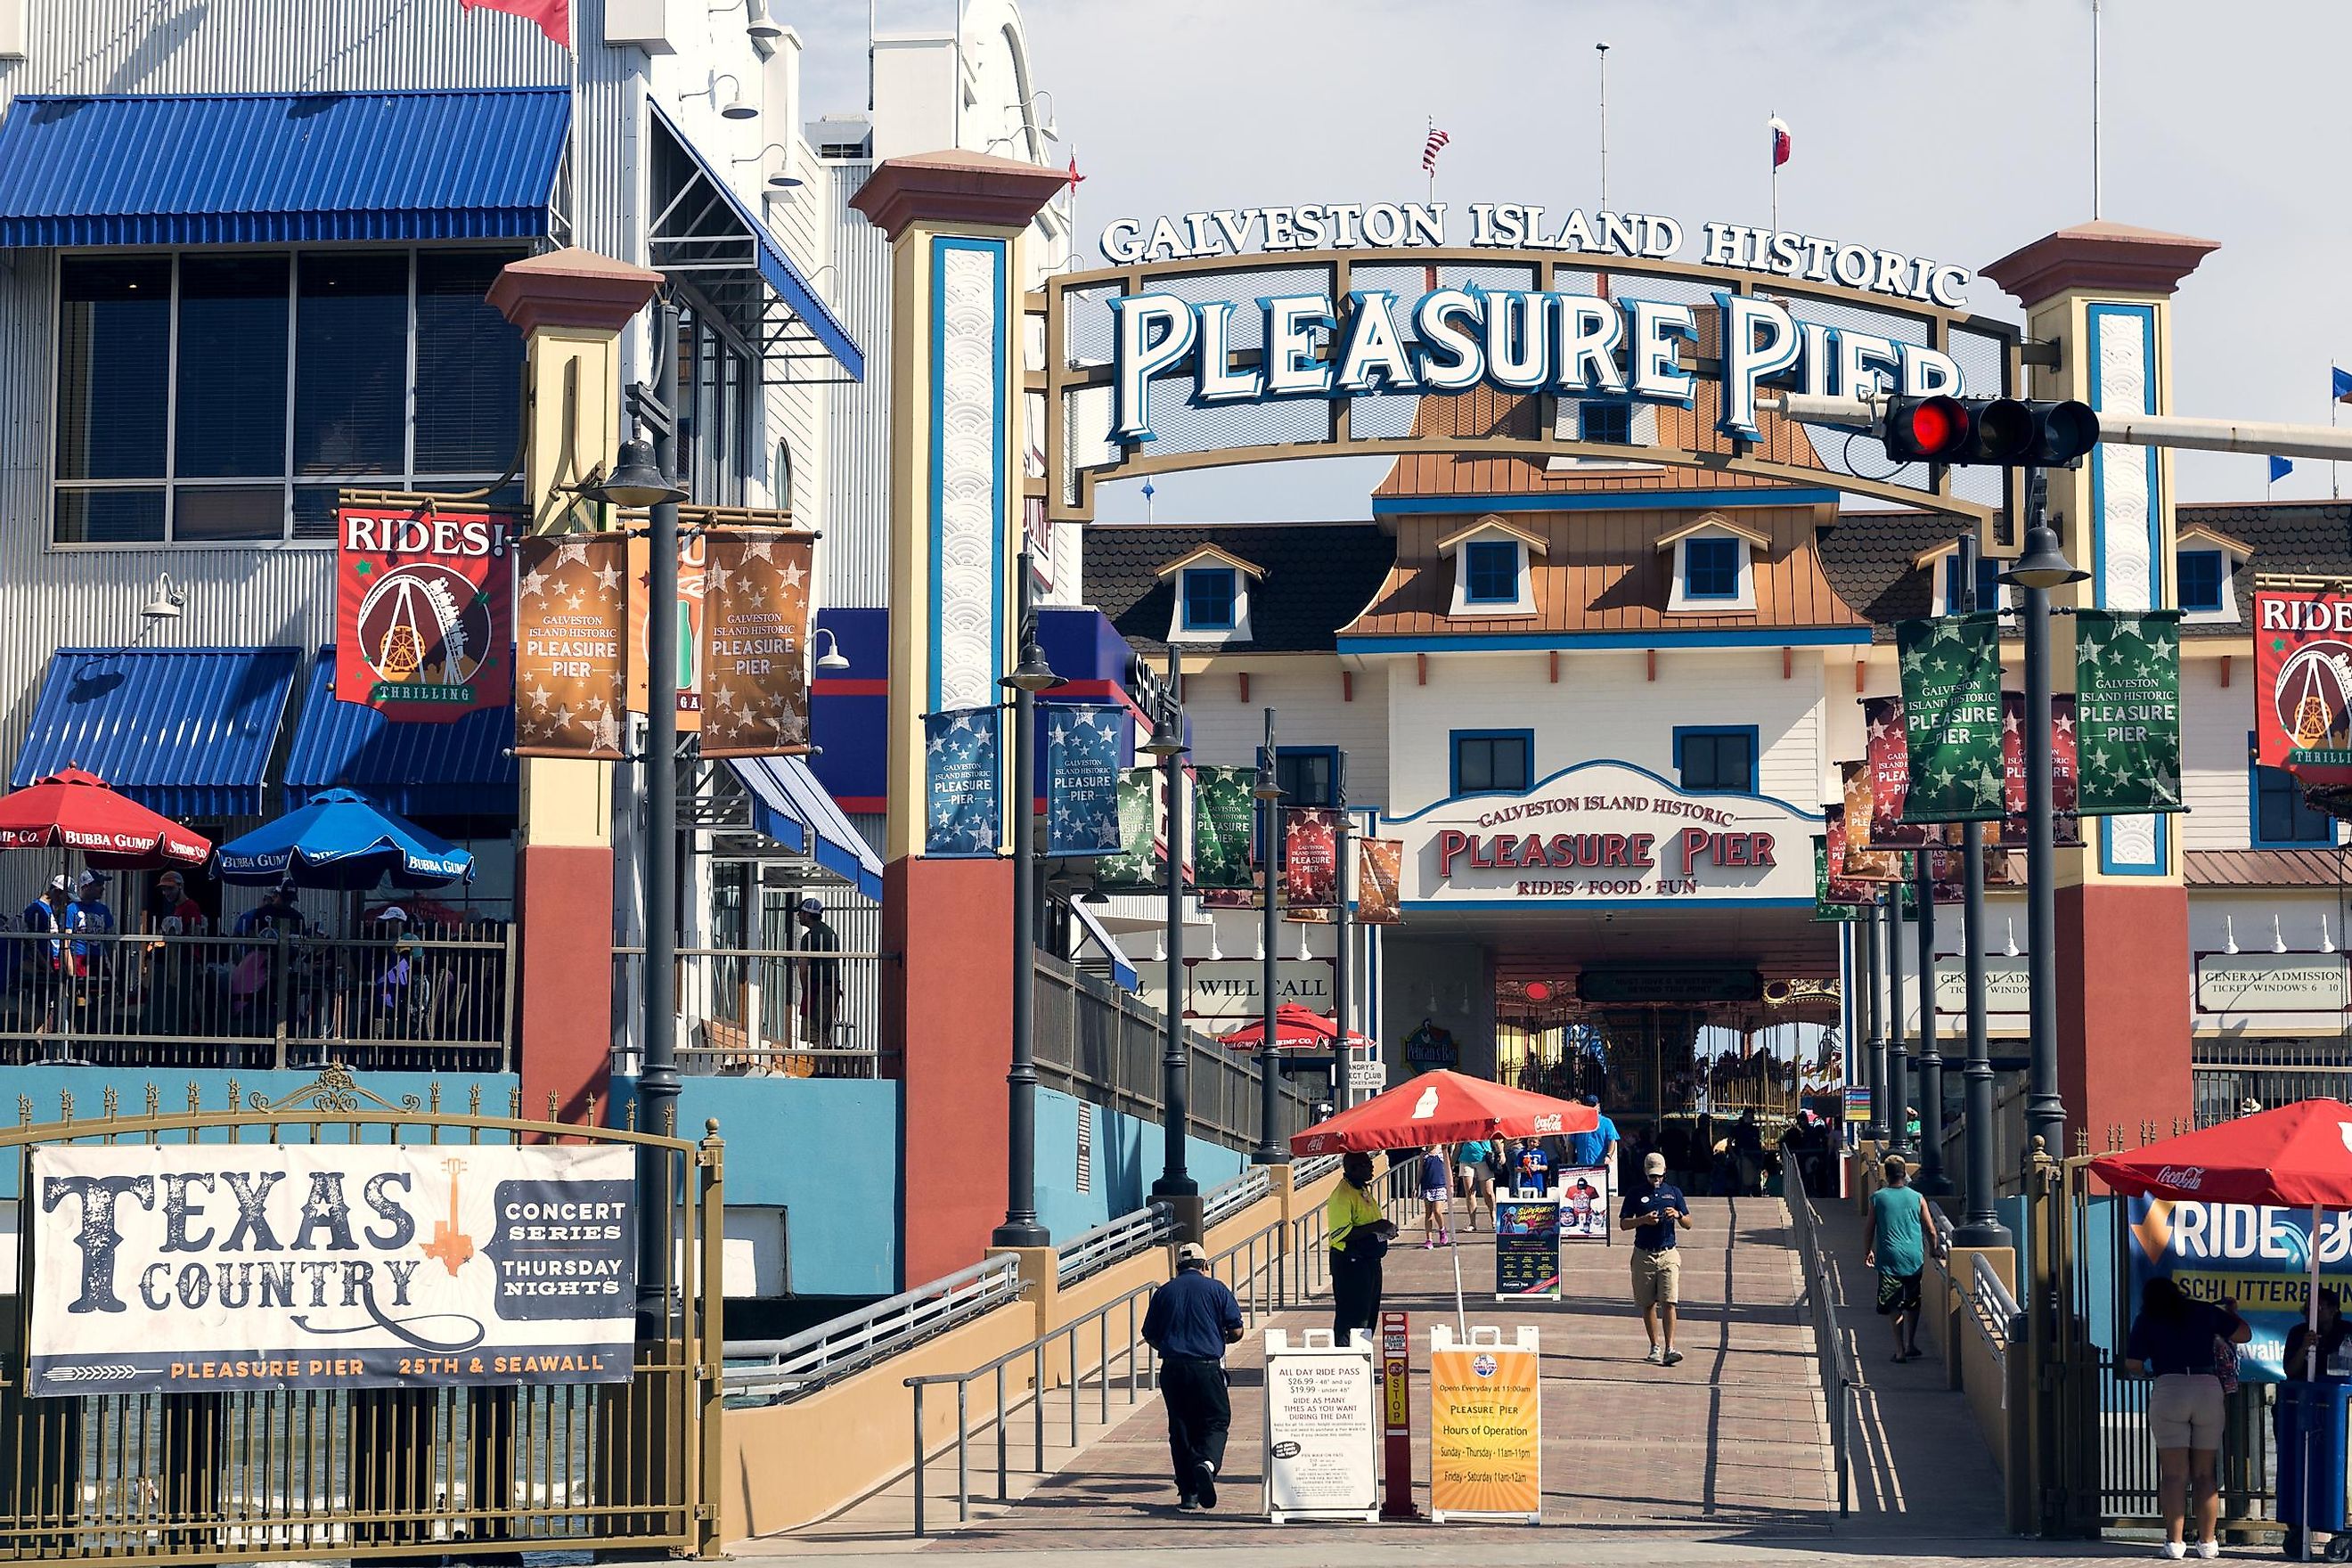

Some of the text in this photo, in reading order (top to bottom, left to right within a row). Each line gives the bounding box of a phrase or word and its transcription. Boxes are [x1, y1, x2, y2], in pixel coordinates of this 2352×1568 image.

[1099, 201, 1971, 308] GALVESTON ISLAND HISTORIC
[1105, 280, 1698, 445] PLEASURE
[344, 515, 505, 558] RIDES!
[543, 616, 603, 625] GALVESTON
[727, 613, 782, 624] GALVESTON
[528, 626, 617, 638] ISLAND HISTORIC
[713, 625, 795, 636] ISLAND HISTORIC
[527, 641, 617, 658] PLEASURE
[712, 638, 795, 657] PLEASURE
[551, 660, 592, 677] PIER
[735, 658, 772, 675] PIER
[1922, 681, 1980, 698] GALVESTON
[2095, 678, 2159, 690] GALVESTON
[379, 684, 470, 702] THRILLING
[2080, 690, 2176, 703] ISLAND HISTORIC
[1908, 692, 1997, 712] ISLAND HISTORIC
[1908, 706, 1998, 731] PLEASURE
[2080, 704, 2176, 723] PLEASURE
[1933, 728, 1972, 746] PIER
[2107, 726, 2148, 744] PIER
[943, 762, 983, 772] GALVESTON
[1055, 766, 1111, 776] ISLAND HISTORIC
[1064, 759, 1102, 767] GALVESTON
[935, 770, 991, 780] ISLAND HISTORIC
[1054, 776, 1111, 789] PLEASURE
[935, 779, 992, 794] PLEASURE
[951, 794, 975, 804] PIER
[1070, 790, 1095, 801] PIER
[1477, 796, 1738, 829] GALVESTON ISLAND HISTORIC
[1197, 821, 1250, 832] PLEASURE
[65, 829, 155, 851] BUBBA GUMP
[1212, 833, 1235, 844] PIER
[1291, 856, 1332, 864] PLEASURE
[1439, 828, 1655, 878] PLEASURE
[1680, 827, 1778, 876] PIER
[225, 853, 288, 869] BUBBA GUM
[408, 855, 467, 876] BUBBA GUM
[1516, 879, 1697, 896] RIDES FOOD FUN
[2205, 971, 2343, 982] GENERAL ADMISSION
[1197, 979, 1260, 997] WILL
[2212, 984, 2339, 992] TICKET WINDOWS 6 10
[1364, 1071, 1382, 1080] CLUB
[503, 1201, 627, 1222] CONCERT
[509, 1224, 623, 1241] SERIES
[43, 1171, 421, 1314] TEXAS
[501, 1258, 624, 1278] THURSDAY
[502, 1278, 622, 1297] NIGHTS
[170, 1354, 605, 1380] PLEASURE PIER 25TH & SEAWALL
[1278, 1368, 1293, 1376] ALL
[1295, 1368, 1314, 1376] DAY
[1287, 1377, 1314, 1385] $26.99
[1439, 1384, 1460, 1392] Opens
[1461, 1384, 1491, 1393] Everyday
[1501, 1384, 1531, 1392] 11:00am
[1392, 1378, 1401, 1422] STOP
[1450, 1405, 1519, 1415] PLEASURE PIER
[1442, 1425, 1528, 1437] Hours of Operation
[1441, 1446, 1462, 1458] Sunday
[1466, 1447, 1492, 1459] Thursday
[1444, 1471, 1463, 1483] Friday
[1467, 1471, 1492, 1483] Saturday
